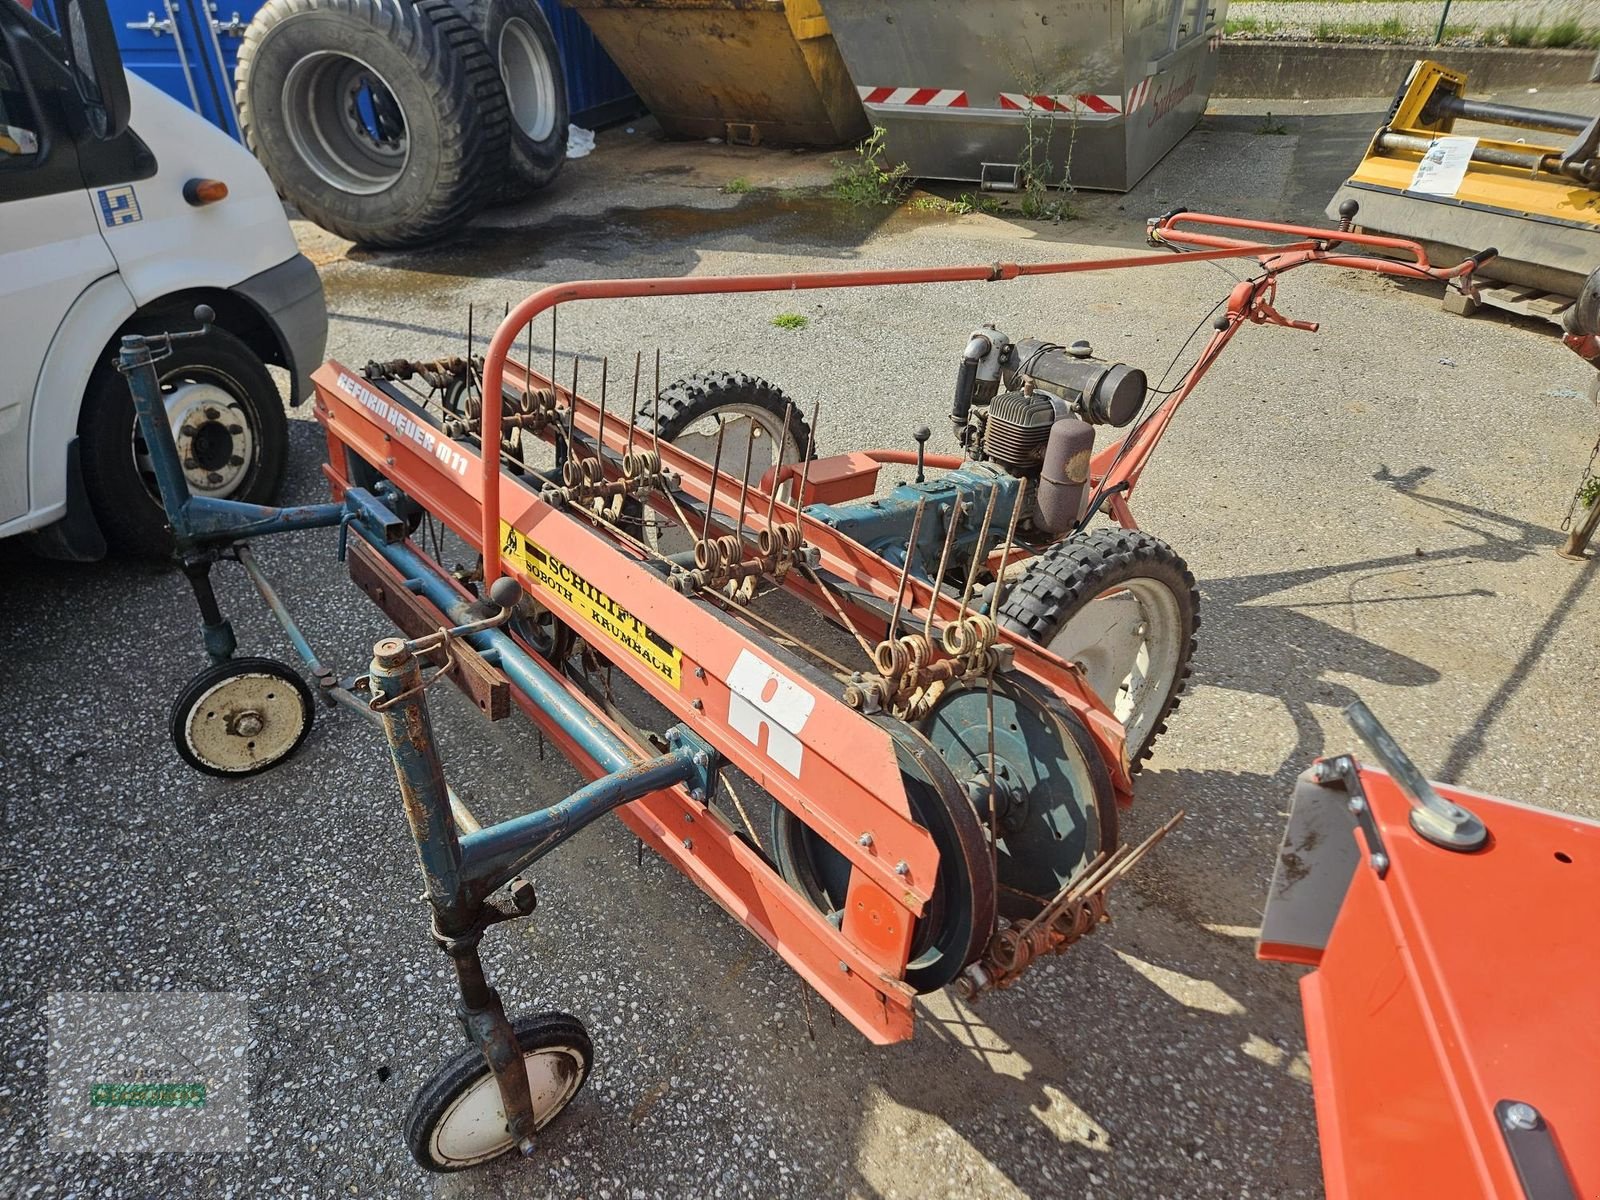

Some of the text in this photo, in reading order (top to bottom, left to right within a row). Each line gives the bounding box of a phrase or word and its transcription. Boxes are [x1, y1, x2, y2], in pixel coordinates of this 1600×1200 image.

[337, 373, 389, 418] REFORM
[387, 408, 436, 453] HEUER
[525, 560, 574, 604] SOBOTH
[591, 608, 673, 680] KRUMBACH
